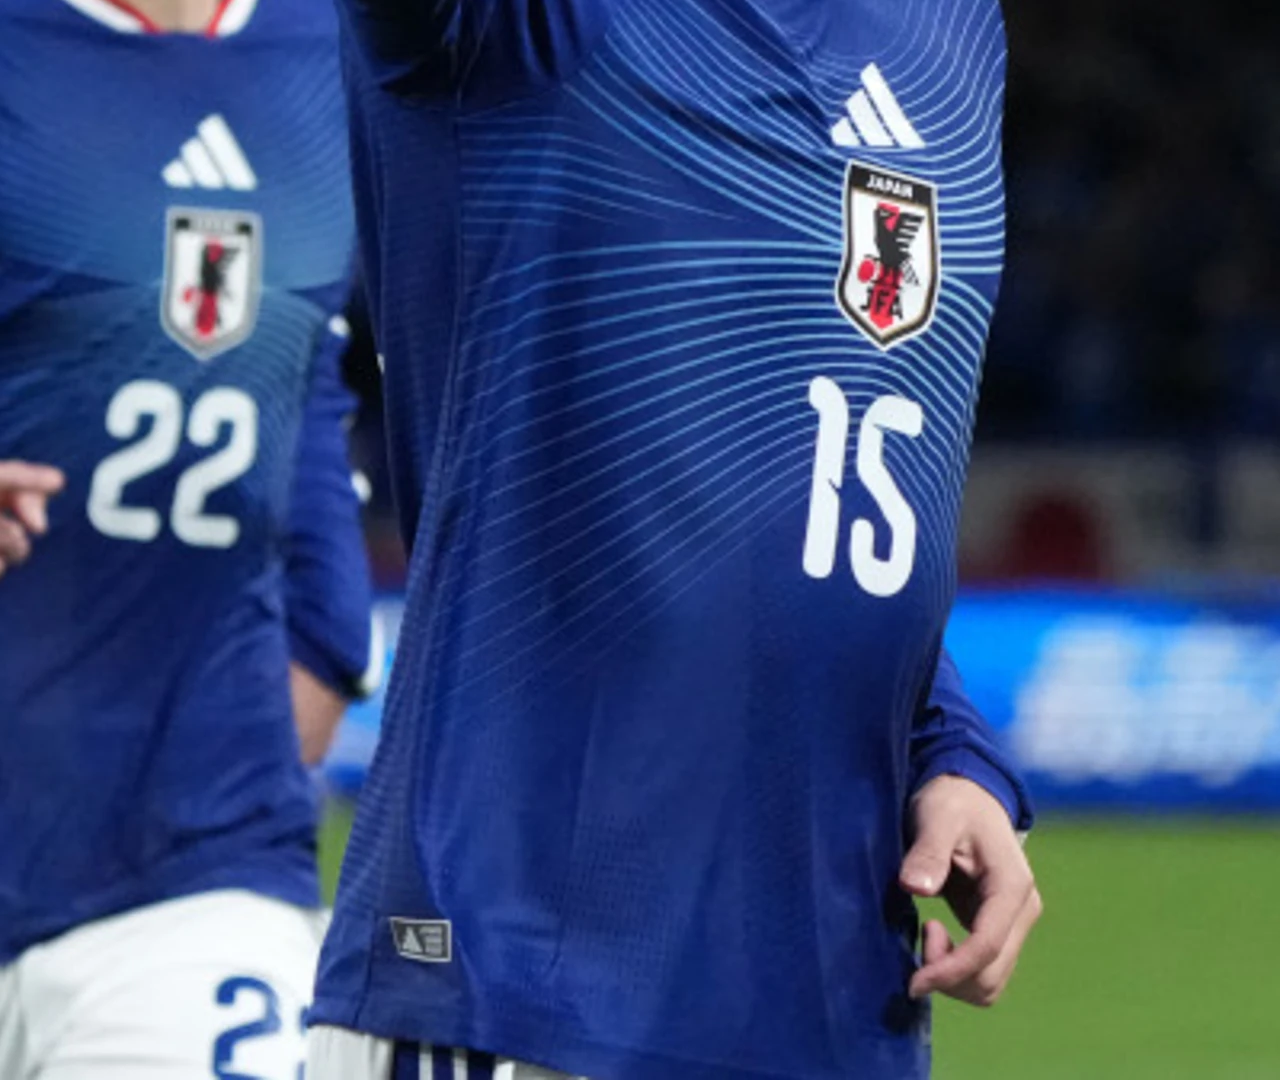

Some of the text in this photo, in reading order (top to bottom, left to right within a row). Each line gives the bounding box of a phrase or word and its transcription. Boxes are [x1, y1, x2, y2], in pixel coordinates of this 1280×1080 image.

[866, 174, 914, 199] JAPAN
[859, 286, 904, 320] JFA
[86, 379, 260, 549] 22
[802, 376, 924, 597] 15
[212, 976, 308, 1080] 2
